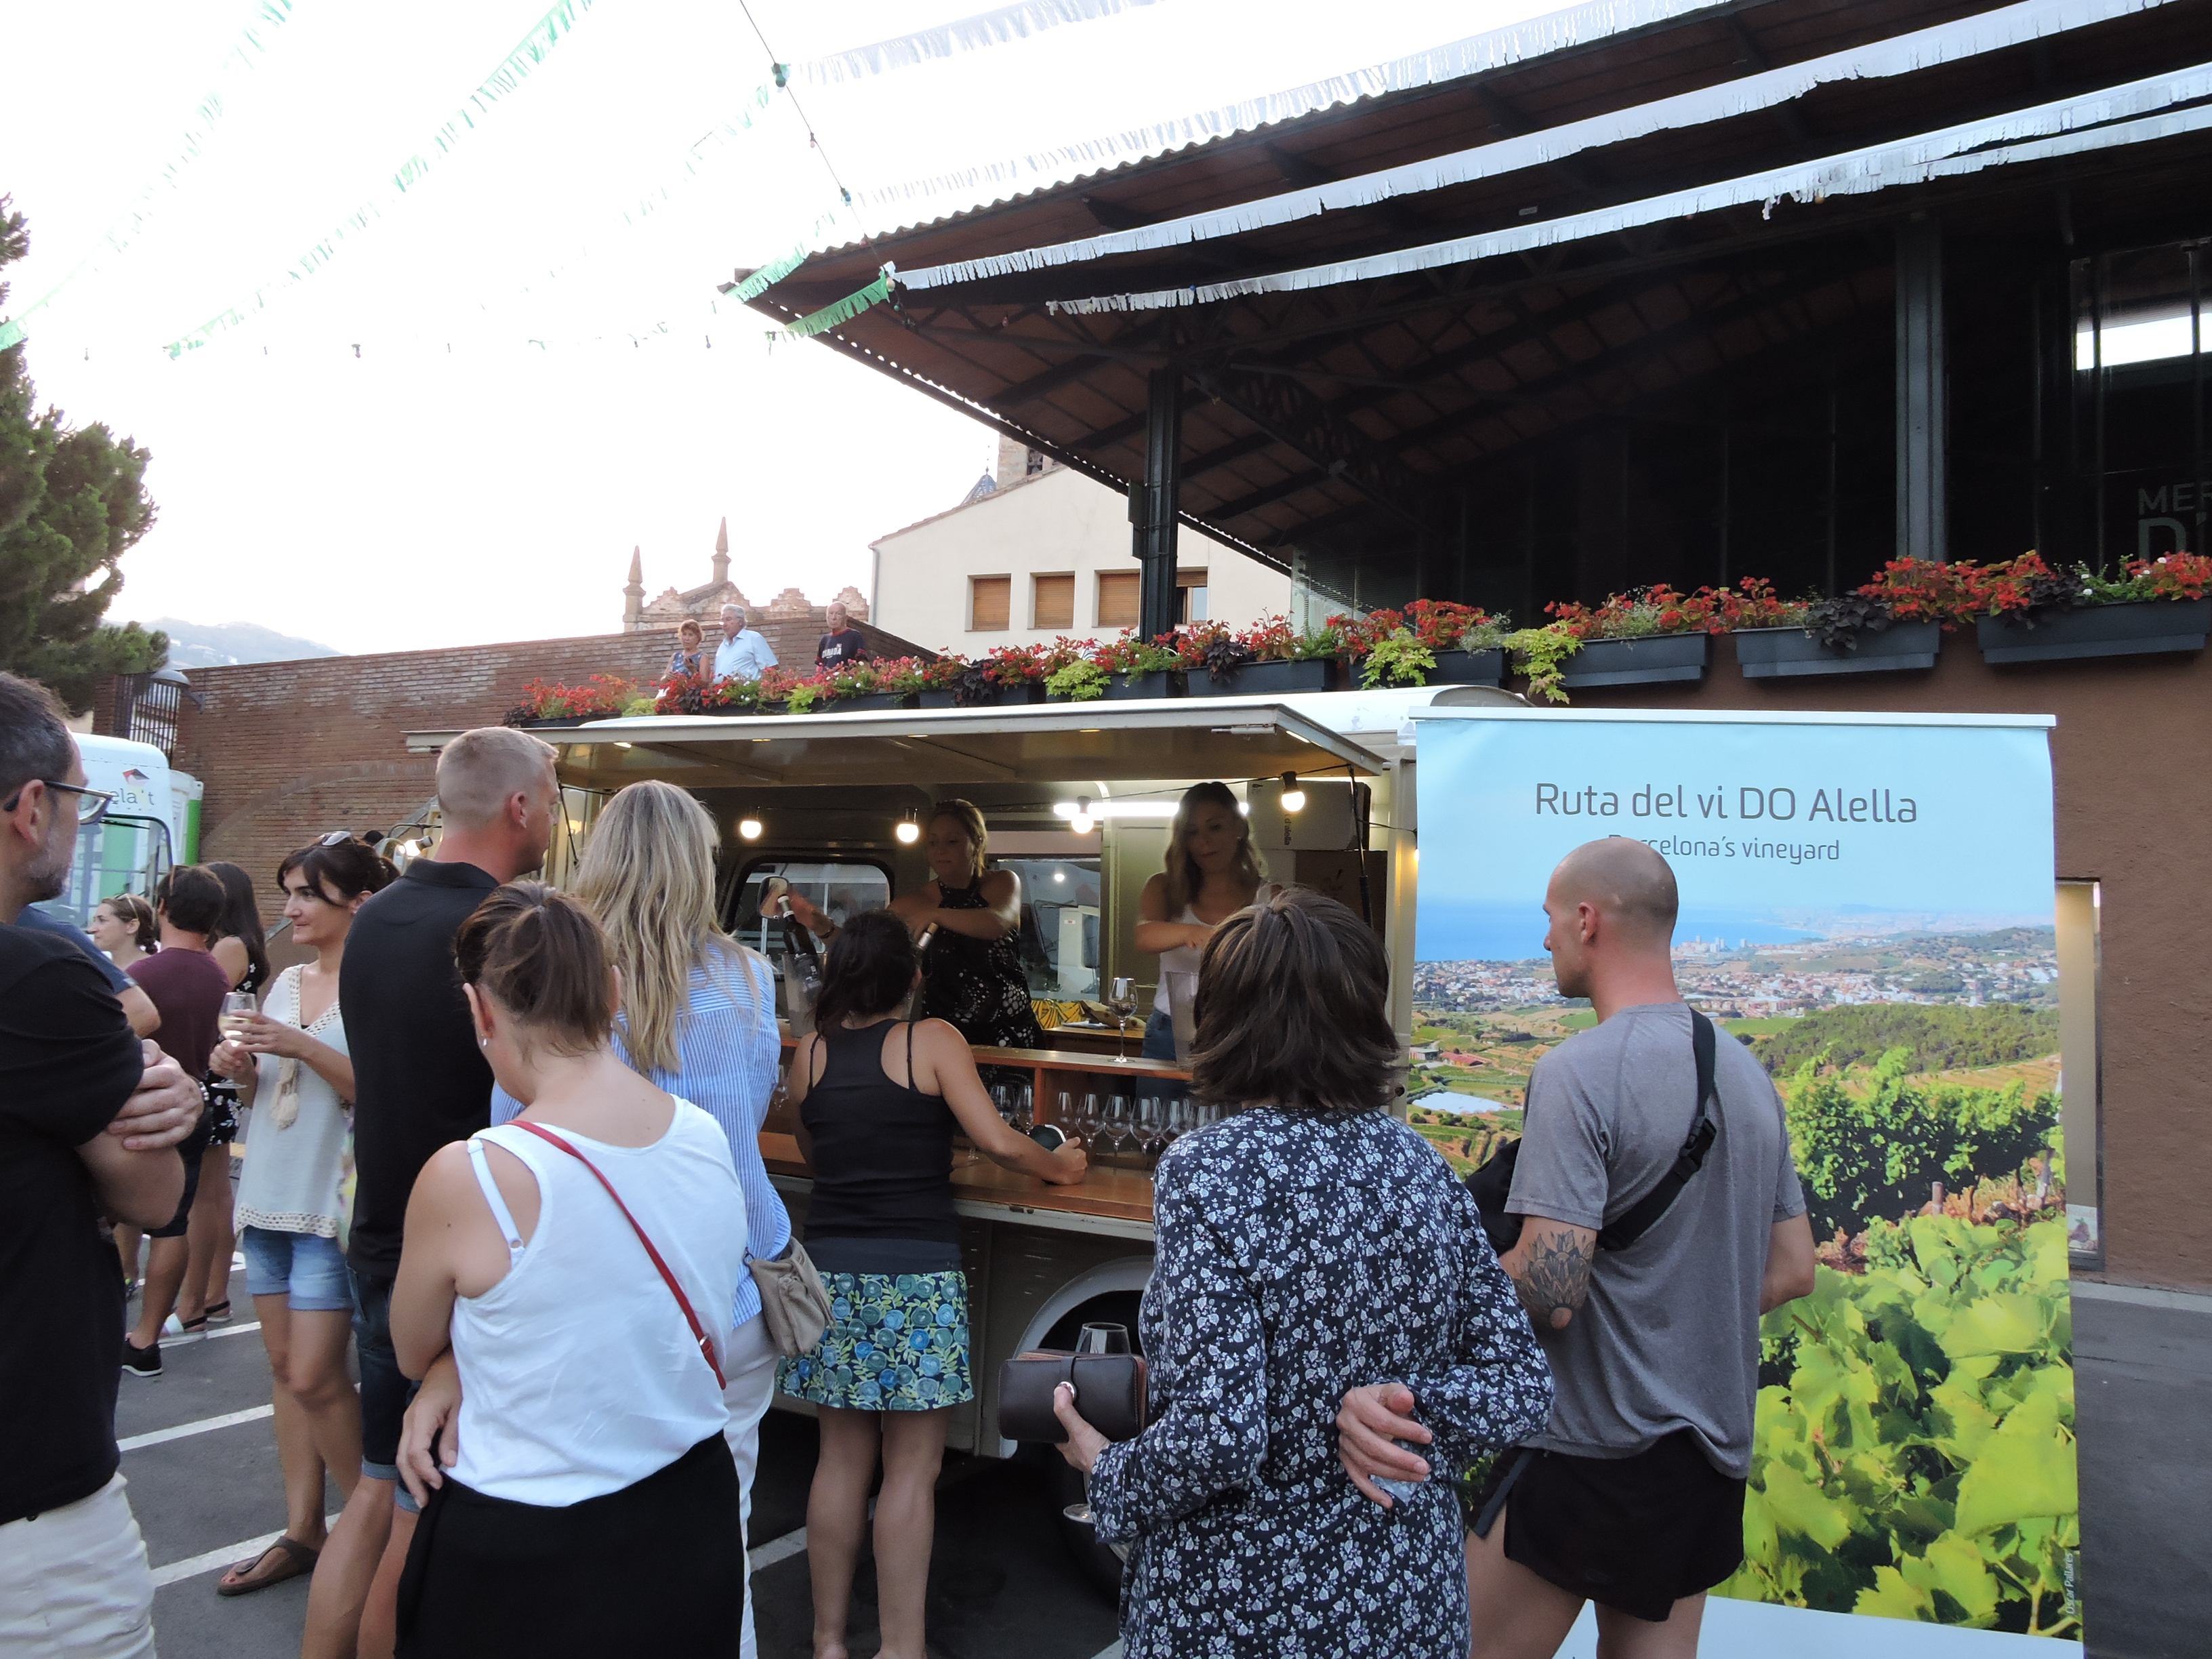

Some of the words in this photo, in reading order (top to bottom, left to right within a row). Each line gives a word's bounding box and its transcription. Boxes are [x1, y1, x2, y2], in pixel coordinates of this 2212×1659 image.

[821, 647, 842, 658] CANADA
[1536, 783, 1618, 816] Ruta
[1632, 783, 1687, 817] del
[1697, 785, 1728, 819] vi
[1740, 787, 1796, 821] DO
[1808, 787, 1917, 823] Alella
[1609, 834, 1736, 857] celona's
[1742, 837, 1839, 865] vineyard
